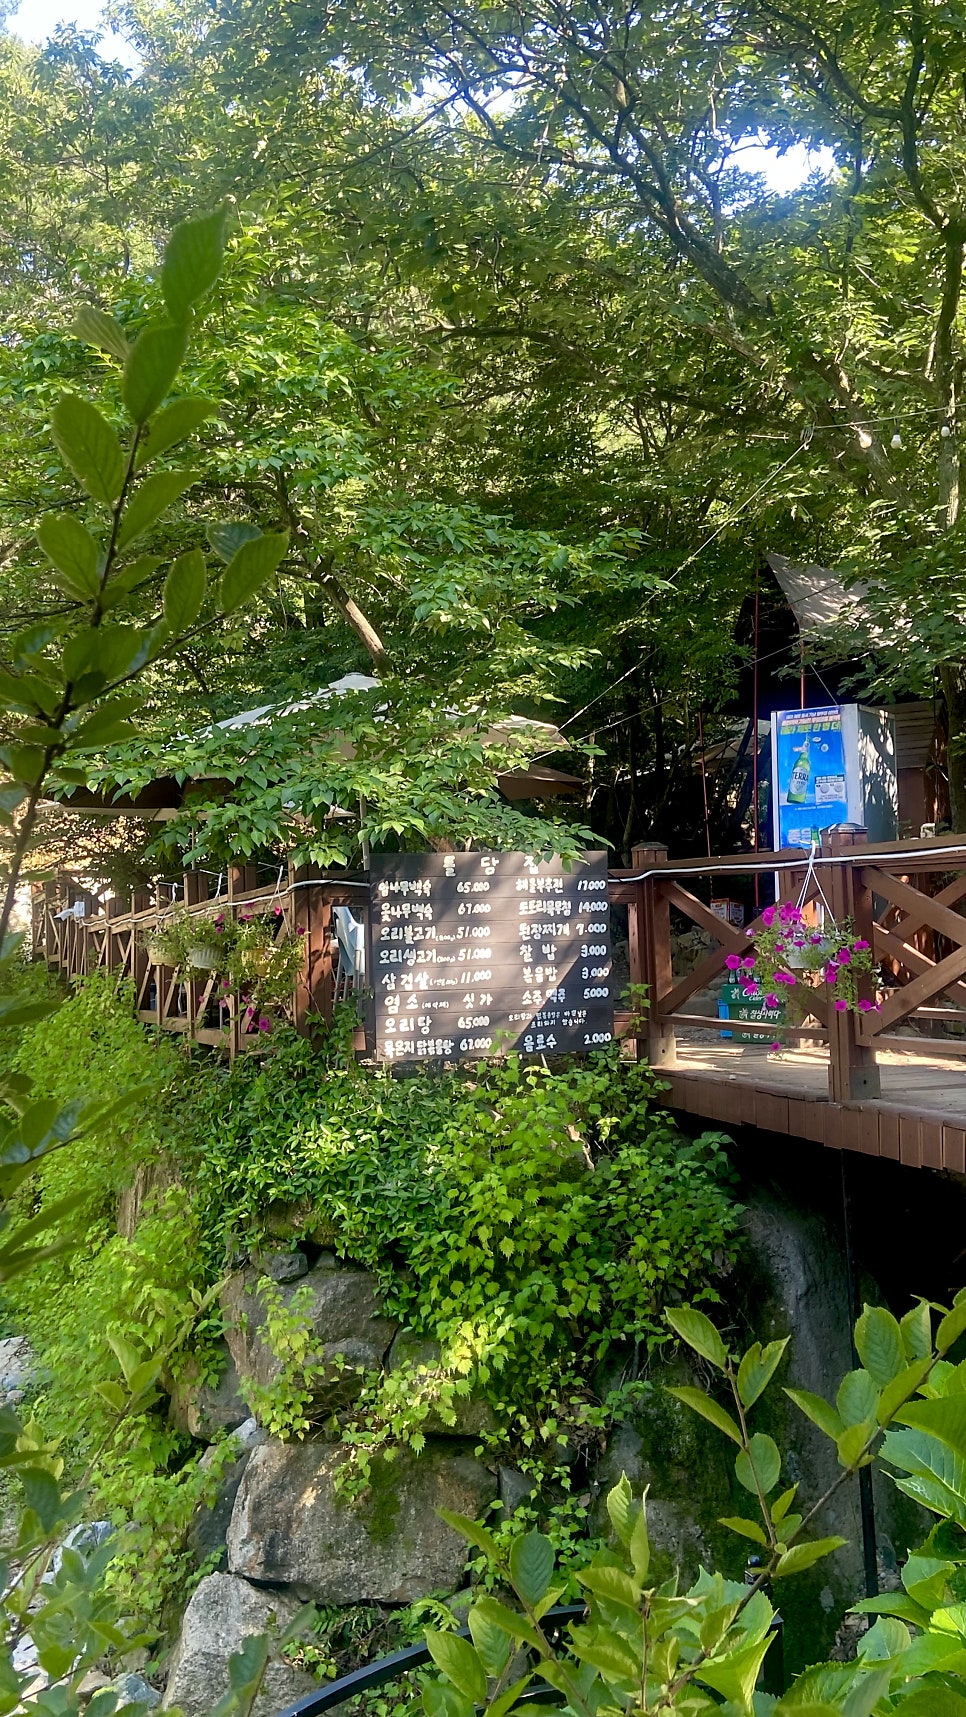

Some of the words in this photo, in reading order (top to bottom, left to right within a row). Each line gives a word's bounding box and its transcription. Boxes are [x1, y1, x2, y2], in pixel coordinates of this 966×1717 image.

[515, 877, 564, 894] 해물부추전
[518, 922, 570, 941] 된장찌개
[523, 1033, 558, 1053] 음료수
